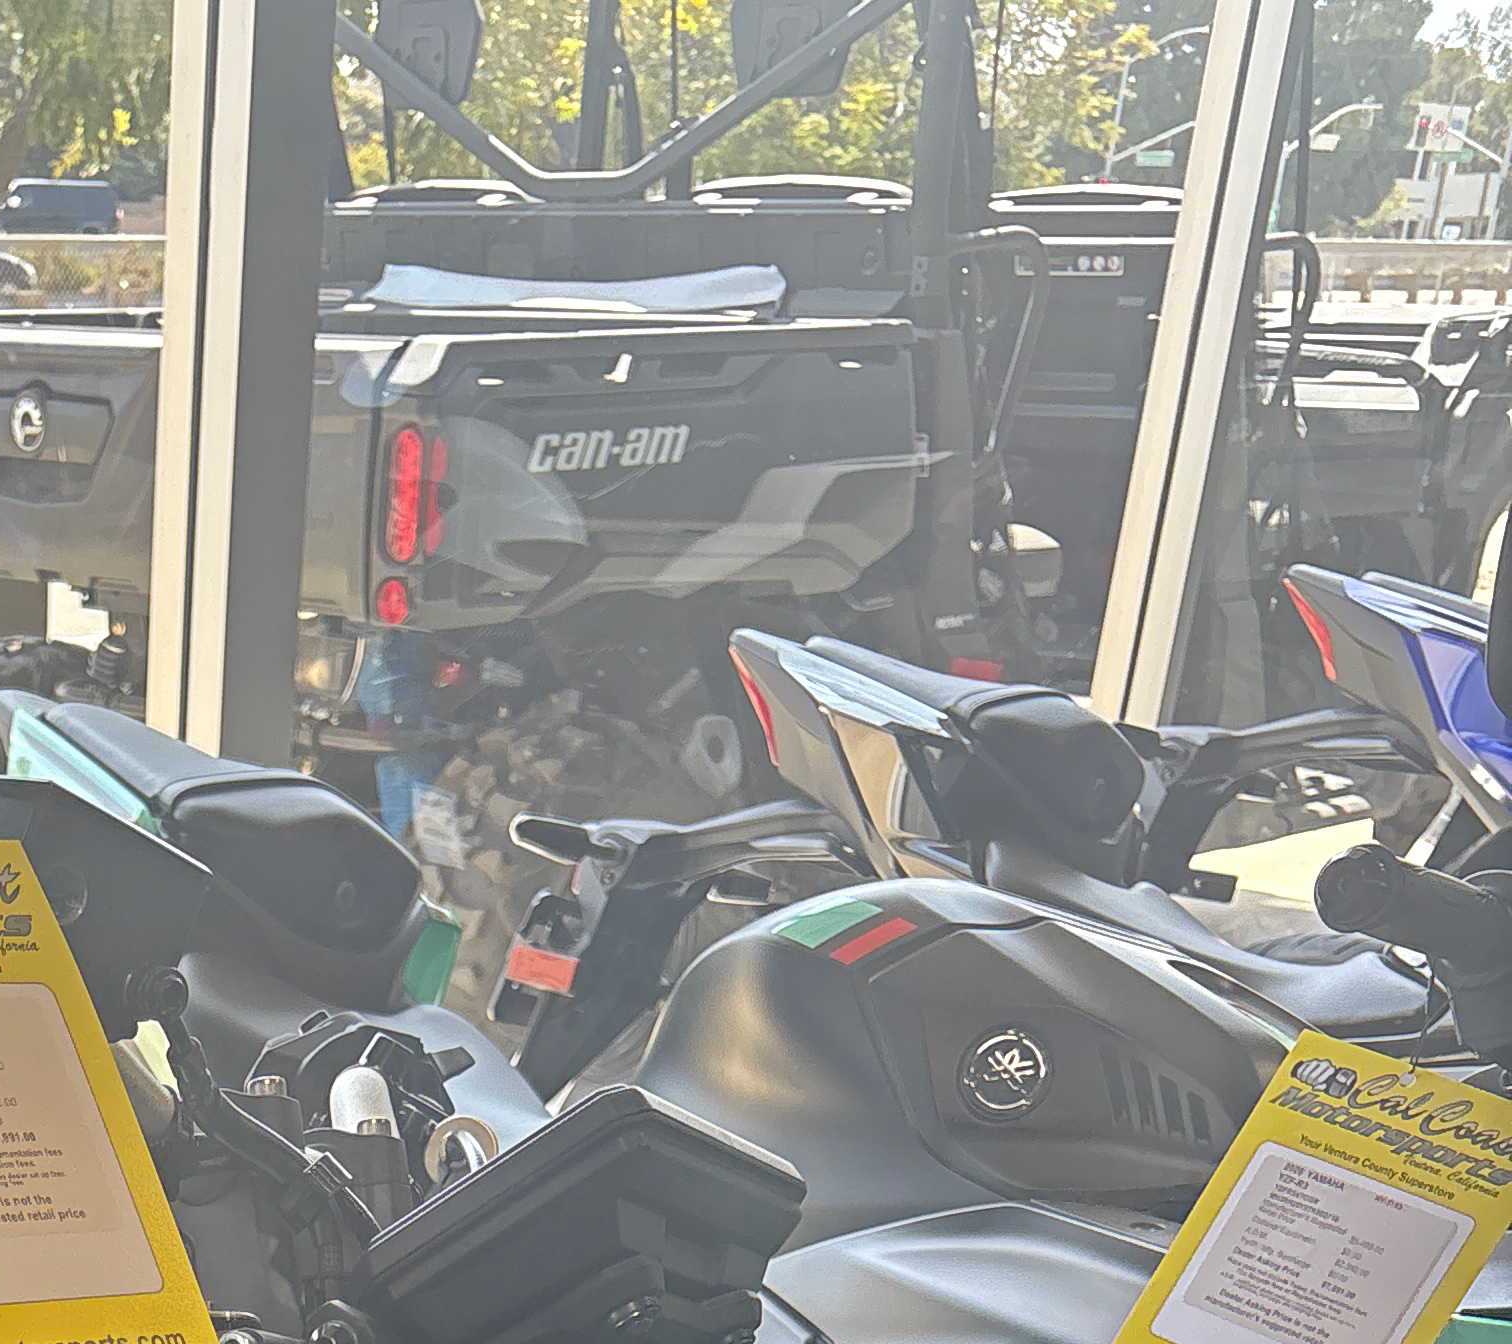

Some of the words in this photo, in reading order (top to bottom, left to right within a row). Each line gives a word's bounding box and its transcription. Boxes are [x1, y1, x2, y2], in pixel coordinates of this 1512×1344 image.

[527, 423, 689, 474] can-am
[1347, 1073, 1435, 1120] Cal
[1298, 1134, 1322, 1151] Your
[1322, 1142, 1361, 1165] Ventura
[1359, 1156, 1399, 1181] County
[1397, 1170, 1456, 1202] Superstore
[0, 1196, 11, 1208] is
[12, 1195, 33, 1207] not
[34, 1194, 53, 1206] the
[27, 1208, 56, 1221] retail
[58, 1208, 87, 1221] price
